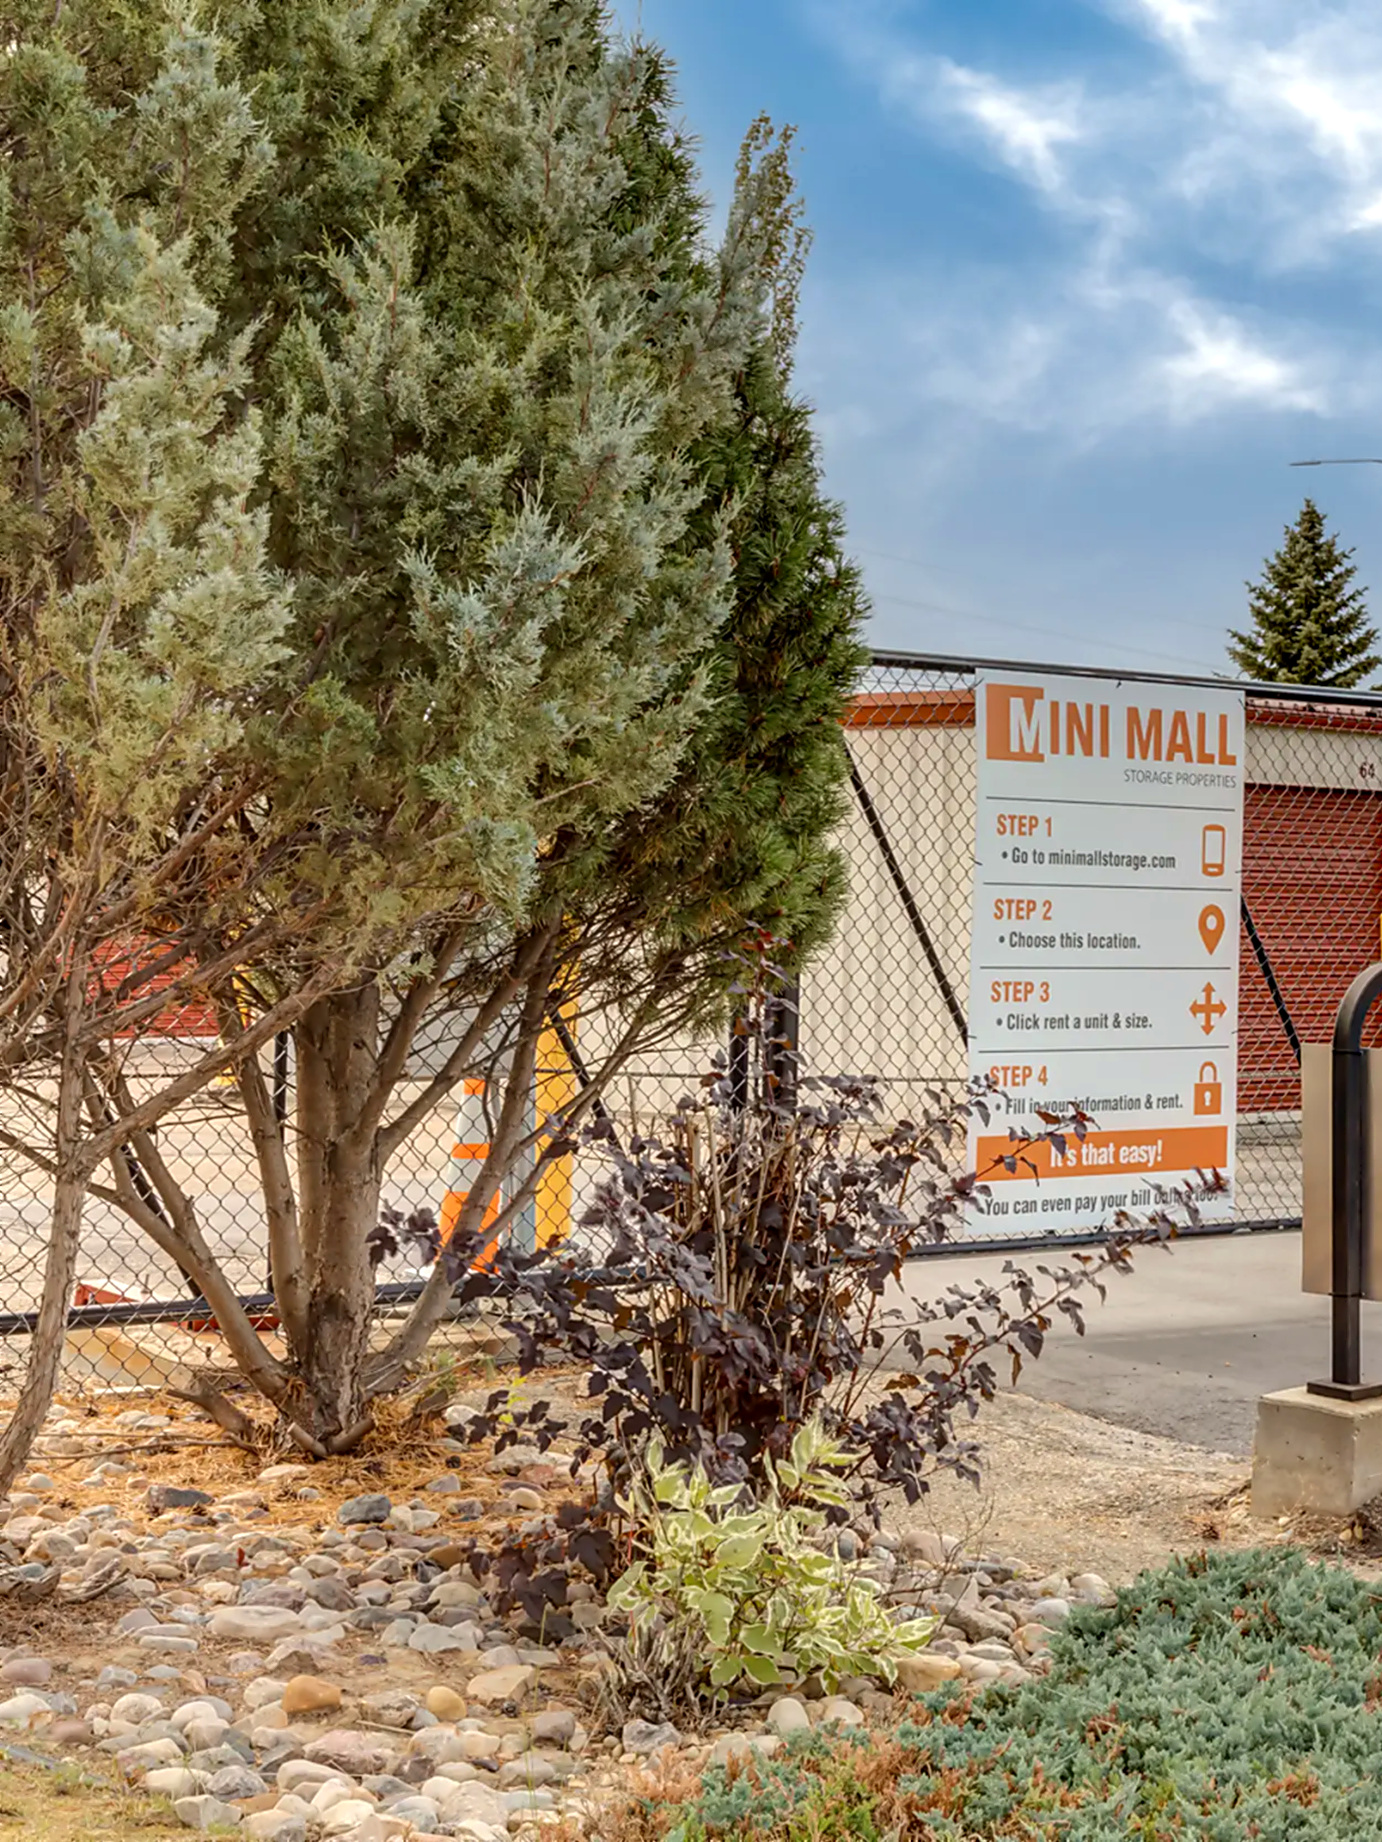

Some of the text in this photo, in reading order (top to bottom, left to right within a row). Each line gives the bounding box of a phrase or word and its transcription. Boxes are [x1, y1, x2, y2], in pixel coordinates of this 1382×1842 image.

[1009, 697, 1237, 766] MINI MALL
[1124, 768, 1237, 788] STORAGE PROPERTIES
[996, 813, 1052, 837] STEP 1
[1012, 847, 1176, 870] Go to minimallstorage.com
[994, 898, 1052, 921] STEP 2
[1009, 931, 1140, 949] Choose this location.
[990, 981, 1050, 1003] STEP 3
[1006, 1013, 1152, 1030] Click rent a unit & size.
[989, 1065, 1048, 1087] STEP 4
[1006, 1098, 1026, 1115] Fill
[1146, 1094, 1155, 1110] &
[1157, 1094, 1183, 1110] rent.
[1081, 1142, 1114, 1165] that
[1119, 1139, 1162, 1168] easy!
[984, 1198, 1009, 1215] You
[1013, 1199, 1037, 1214] can
[1041, 1198, 1071, 1213] even
[1075, 1195, 1098, 1214] pay
[1101, 1191, 1128, 1211] your
[1132, 1188, 1151, 1206] bill
